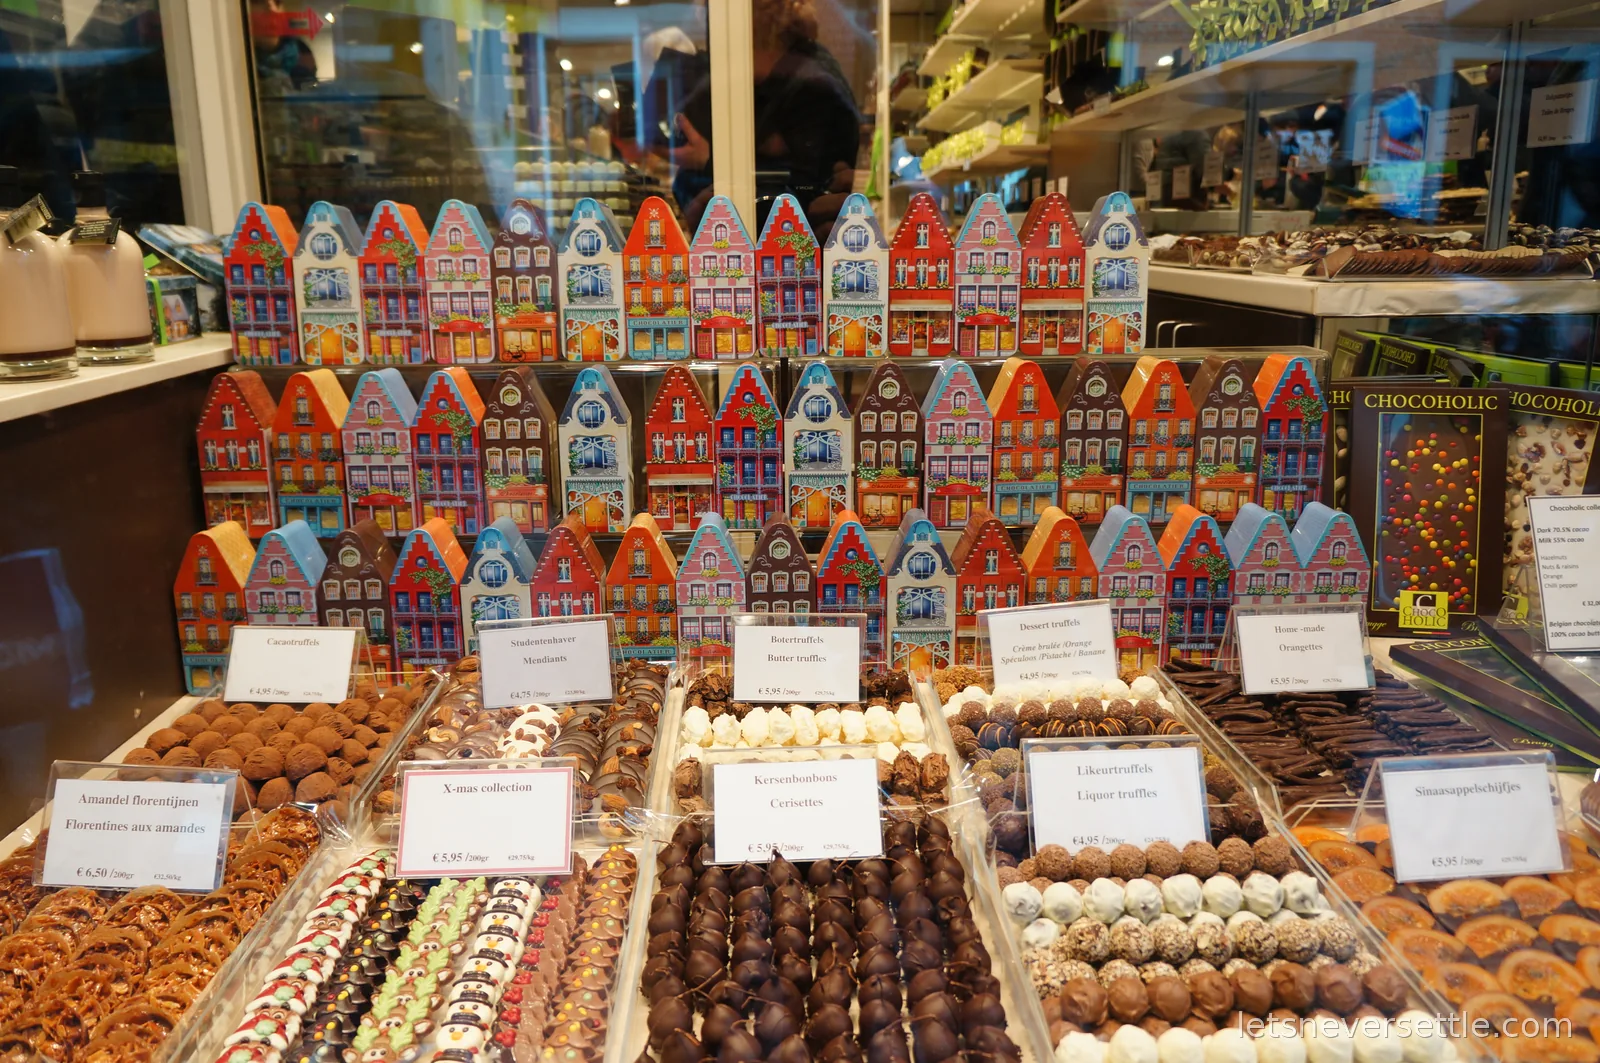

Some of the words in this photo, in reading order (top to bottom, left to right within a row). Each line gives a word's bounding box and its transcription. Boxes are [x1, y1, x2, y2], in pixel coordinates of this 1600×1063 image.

[1364, 394, 1498, 410] CHOCOHOLIC
[1403, 606, 1447, 617] CHOCO
[1020, 622, 1049, 631] Dessert
[1051, 619, 1080, 628] truffels
[1403, 615, 1447, 627] HOLIC
[1274, 625, 1298, 634] Home
[267, 638, 320, 647] Cacaotruffels
[510, 635, 577, 648] Studentenhaver
[771, 635, 824, 644] Botertruffels
[1012, 643, 1036, 653] Crème
[1062, 639, 1092, 650] /Orange
[1279, 643, 1323, 653] Orangettes
[523, 655, 567, 665] Mendiants
[767, 654, 794, 663] Butter
[796, 653, 827, 663] truffles
[1000, 654, 1037, 666] Spéculoos
[1039, 650, 1072, 661] /Pistache
[1079, 648, 1106, 657] Banane
[1019, 672, 1040, 681] €4,95
[1270, 677, 1290, 686] €5,95
[255, 687, 271, 696] 4,95
[510, 690, 532, 700] €4,75
[533, 690, 551, 698] /200gr
[758, 687, 763, 695] €
[765, 687, 781, 696] 5,95
[783, 687, 801, 697] /200gr
[1077, 763, 1153, 776] Likeurtruffels
[754, 773, 838, 785] Kersenbonbons
[443, 783, 479, 794] X-mas
[481, 782, 532, 793] collection
[1415, 782, 1521, 797] Sinaasappelschijfjes
[78, 793, 129, 805] Amandel
[132, 795, 199, 809] florentijnen
[1077, 790, 1115, 803] Liquor
[1118, 788, 1158, 799] truffles
[770, 797, 824, 809] Cerisettes
[65, 819, 129, 832] Florentines
[131, 823, 152, 832] aux
[155, 822, 206, 834] amandes
[1072, 835, 1099, 846] €4,95
[748, 843, 754, 853] €
[780, 842, 804, 852] /200gr
[432, 853, 439, 863] €
[441, 852, 463, 863] 5,95
[464, 852, 490, 863] /200gr
[507, 854, 535, 862] €29,75/kg
[1431, 856, 1458, 867] €5,95
[1460, 855, 1484, 866] /200gr
[76, 867, 83, 877] €
[85, 867, 108, 878] 6,50
[109, 868, 135, 880] /200gr
